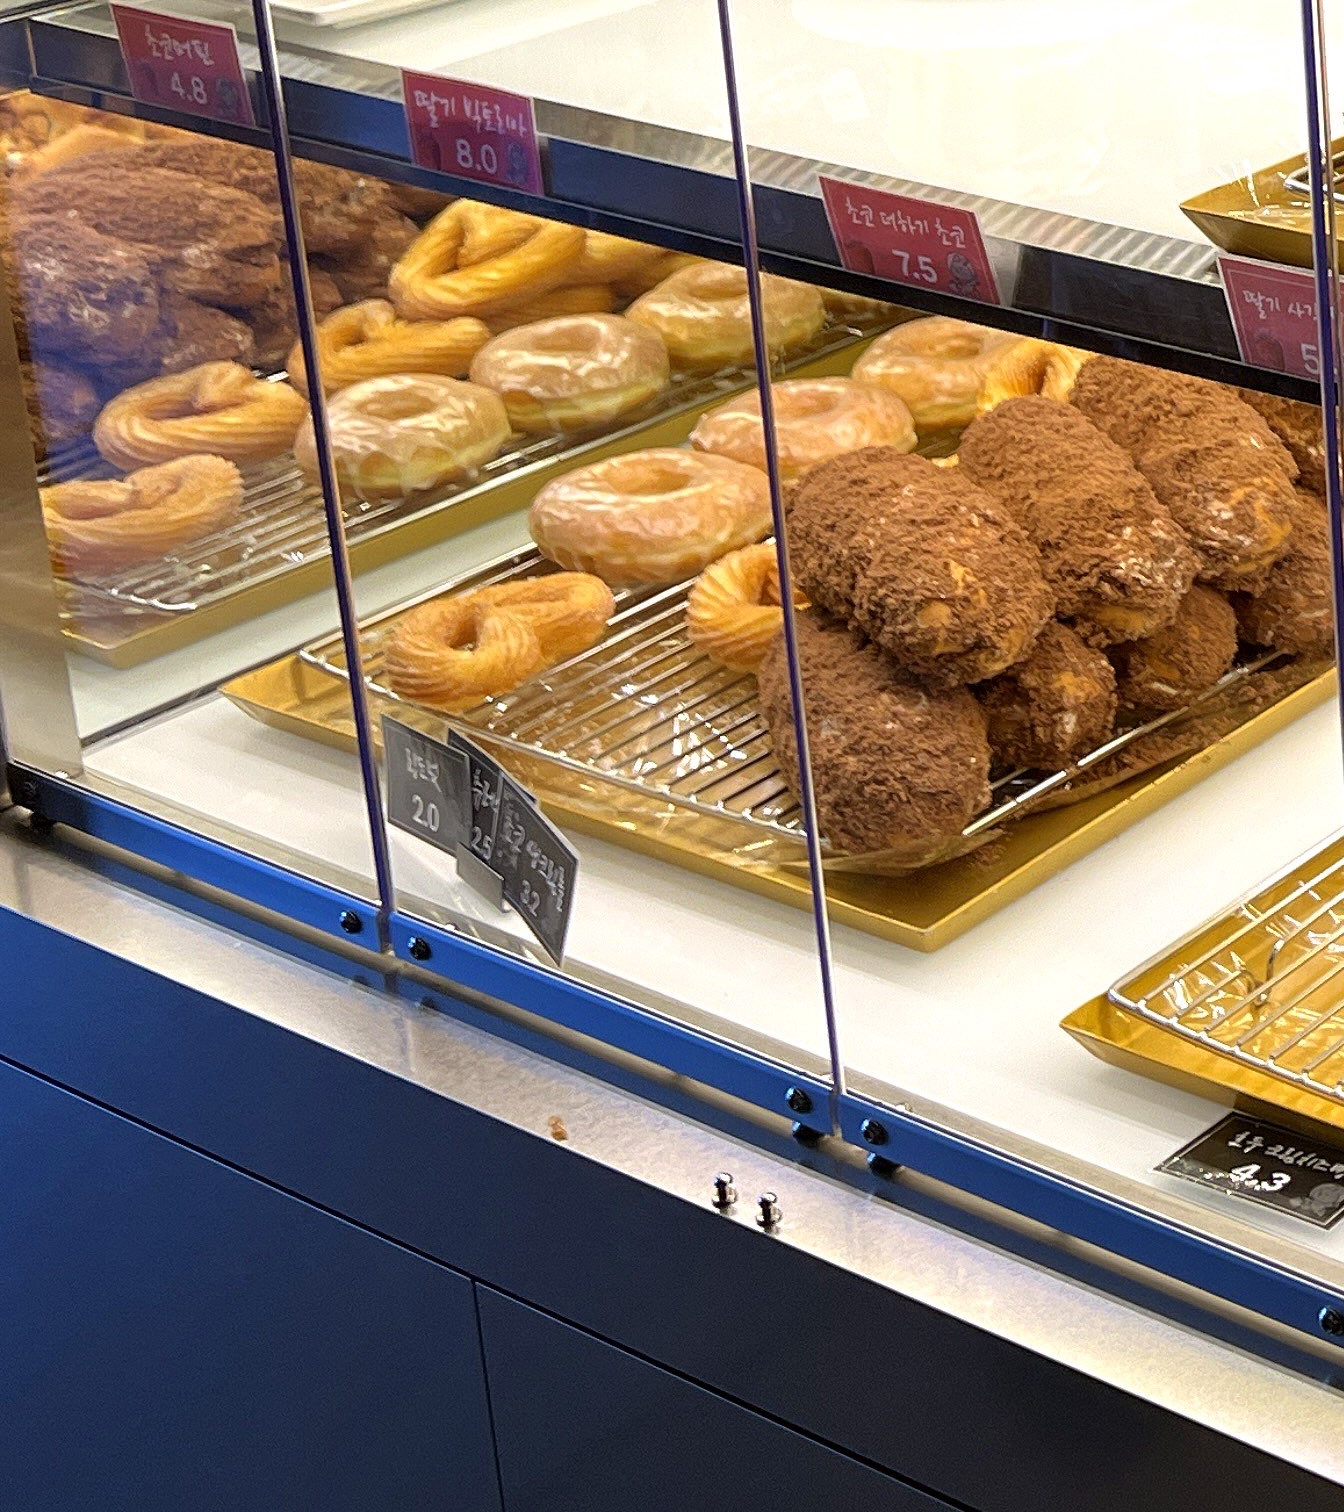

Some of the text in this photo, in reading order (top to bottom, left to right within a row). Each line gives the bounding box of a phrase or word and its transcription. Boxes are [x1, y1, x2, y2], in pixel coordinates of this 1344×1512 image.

[171, 72, 208, 105] 4.8
[413, 90, 456, 129] 딸기
[456, 138, 498, 175] 8.0
[845, 196, 966, 249] 초코 더하기 초코
[891, 248, 938, 284] 7.5
[1242, 289, 1281, 320] 딸기
[1230, 1163, 1292, 1192] 4.3
